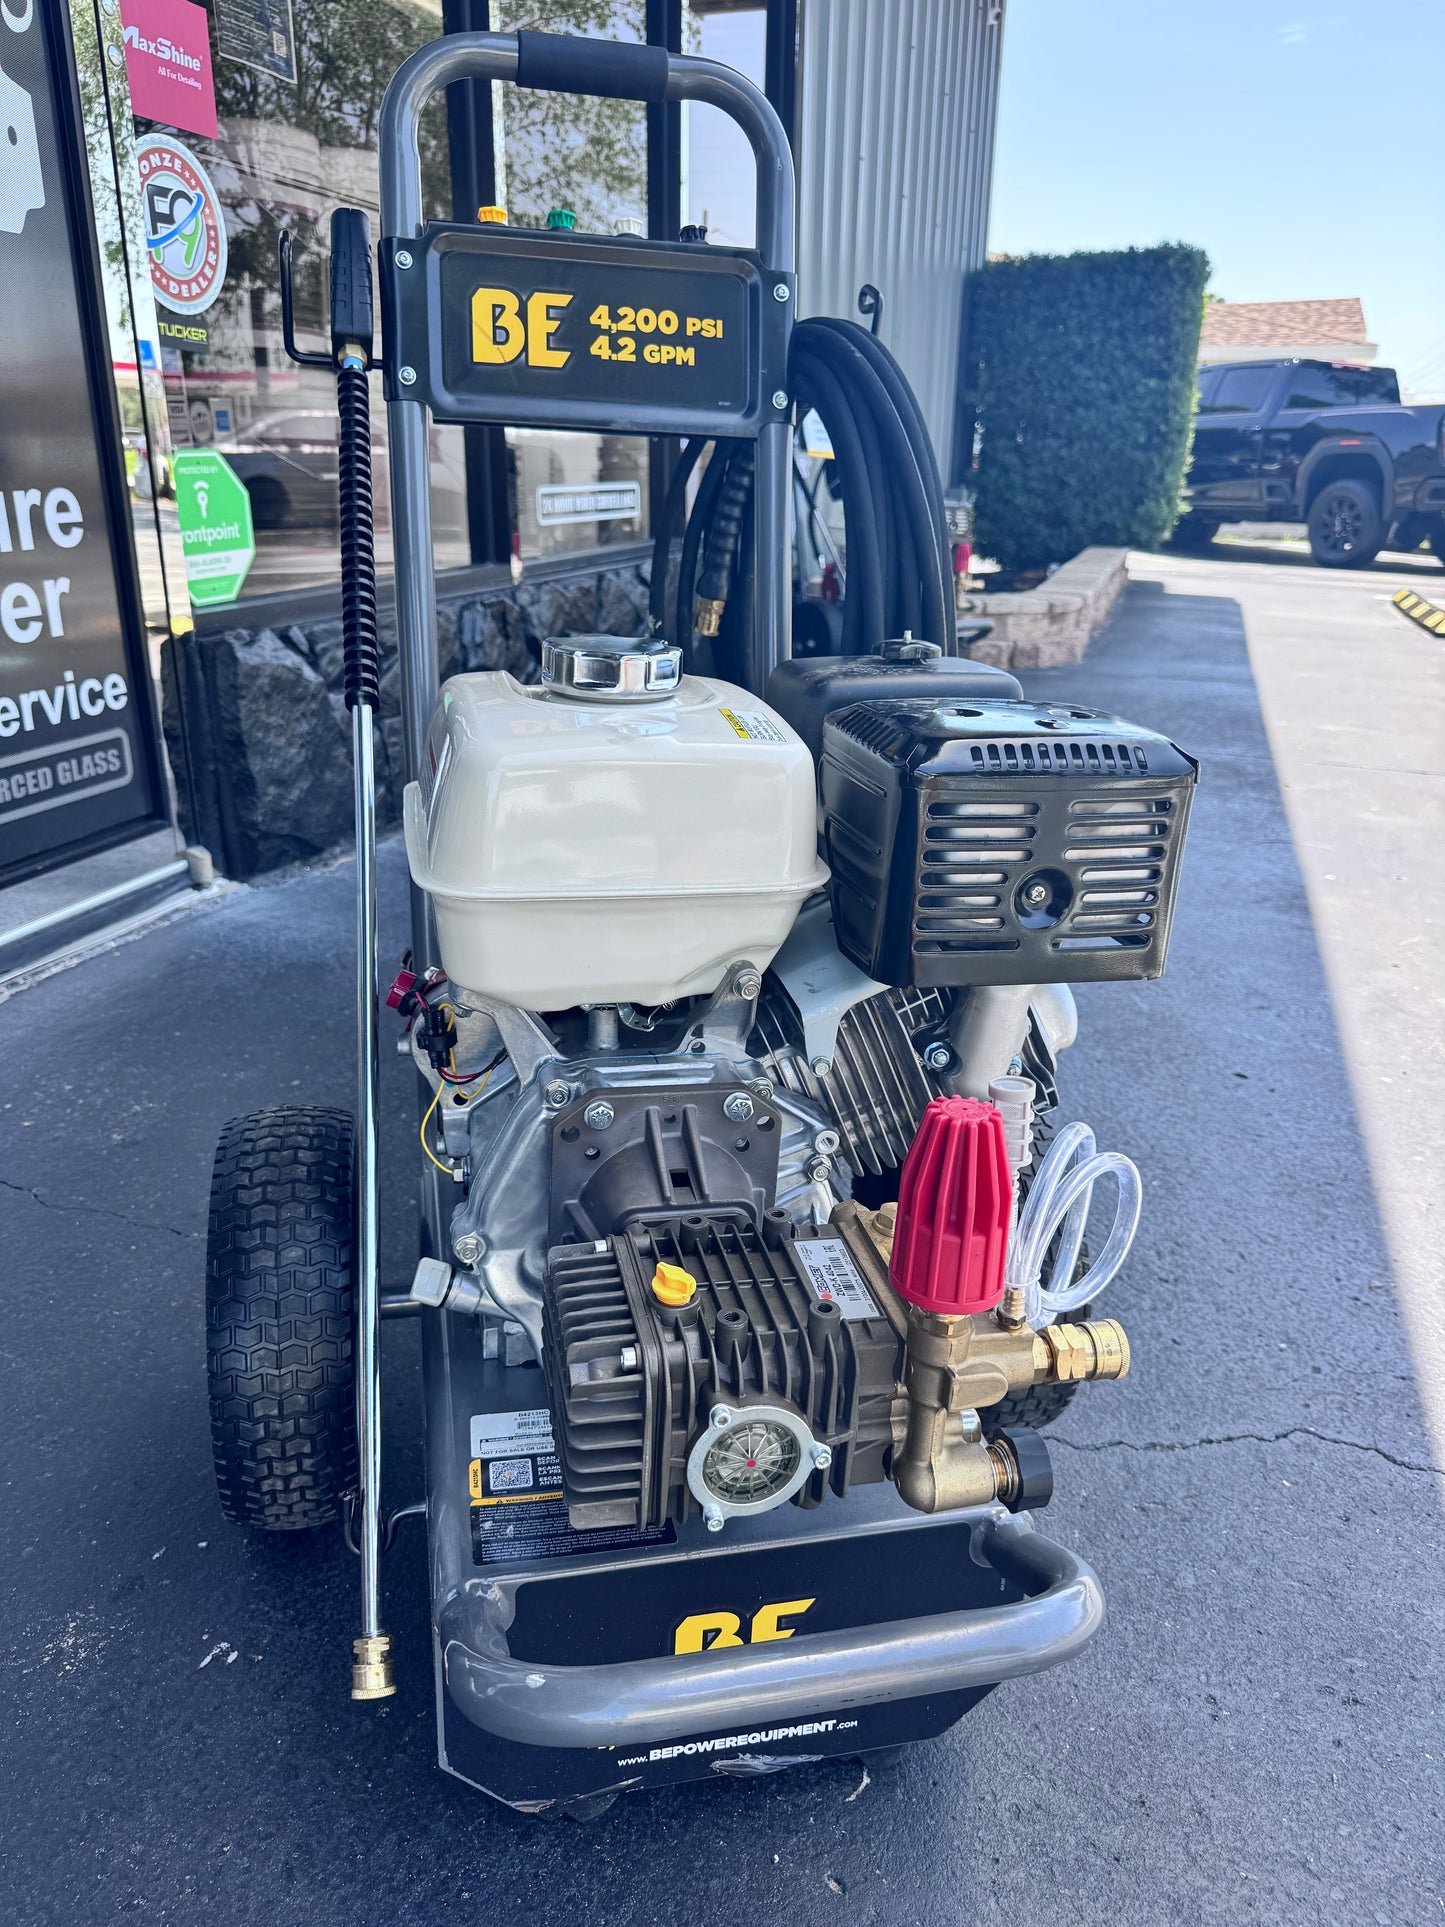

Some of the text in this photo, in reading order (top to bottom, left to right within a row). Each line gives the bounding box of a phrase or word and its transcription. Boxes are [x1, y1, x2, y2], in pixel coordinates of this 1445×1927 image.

[122, 26, 201, 71] MaxShine
[158, 66, 202, 90] All For Detailing
[140, 153, 182, 182] ONZE
[168, 251, 217, 297] DEALER
[158, 322, 207, 342] TUCKER
[472, 288, 573, 368] BE
[589, 304, 723, 338] 4,200 PSI
[589, 335, 695, 366] 4.2 GPM
[0, 670, 128, 737] ervice
[57, 748, 121, 786] GLASS
